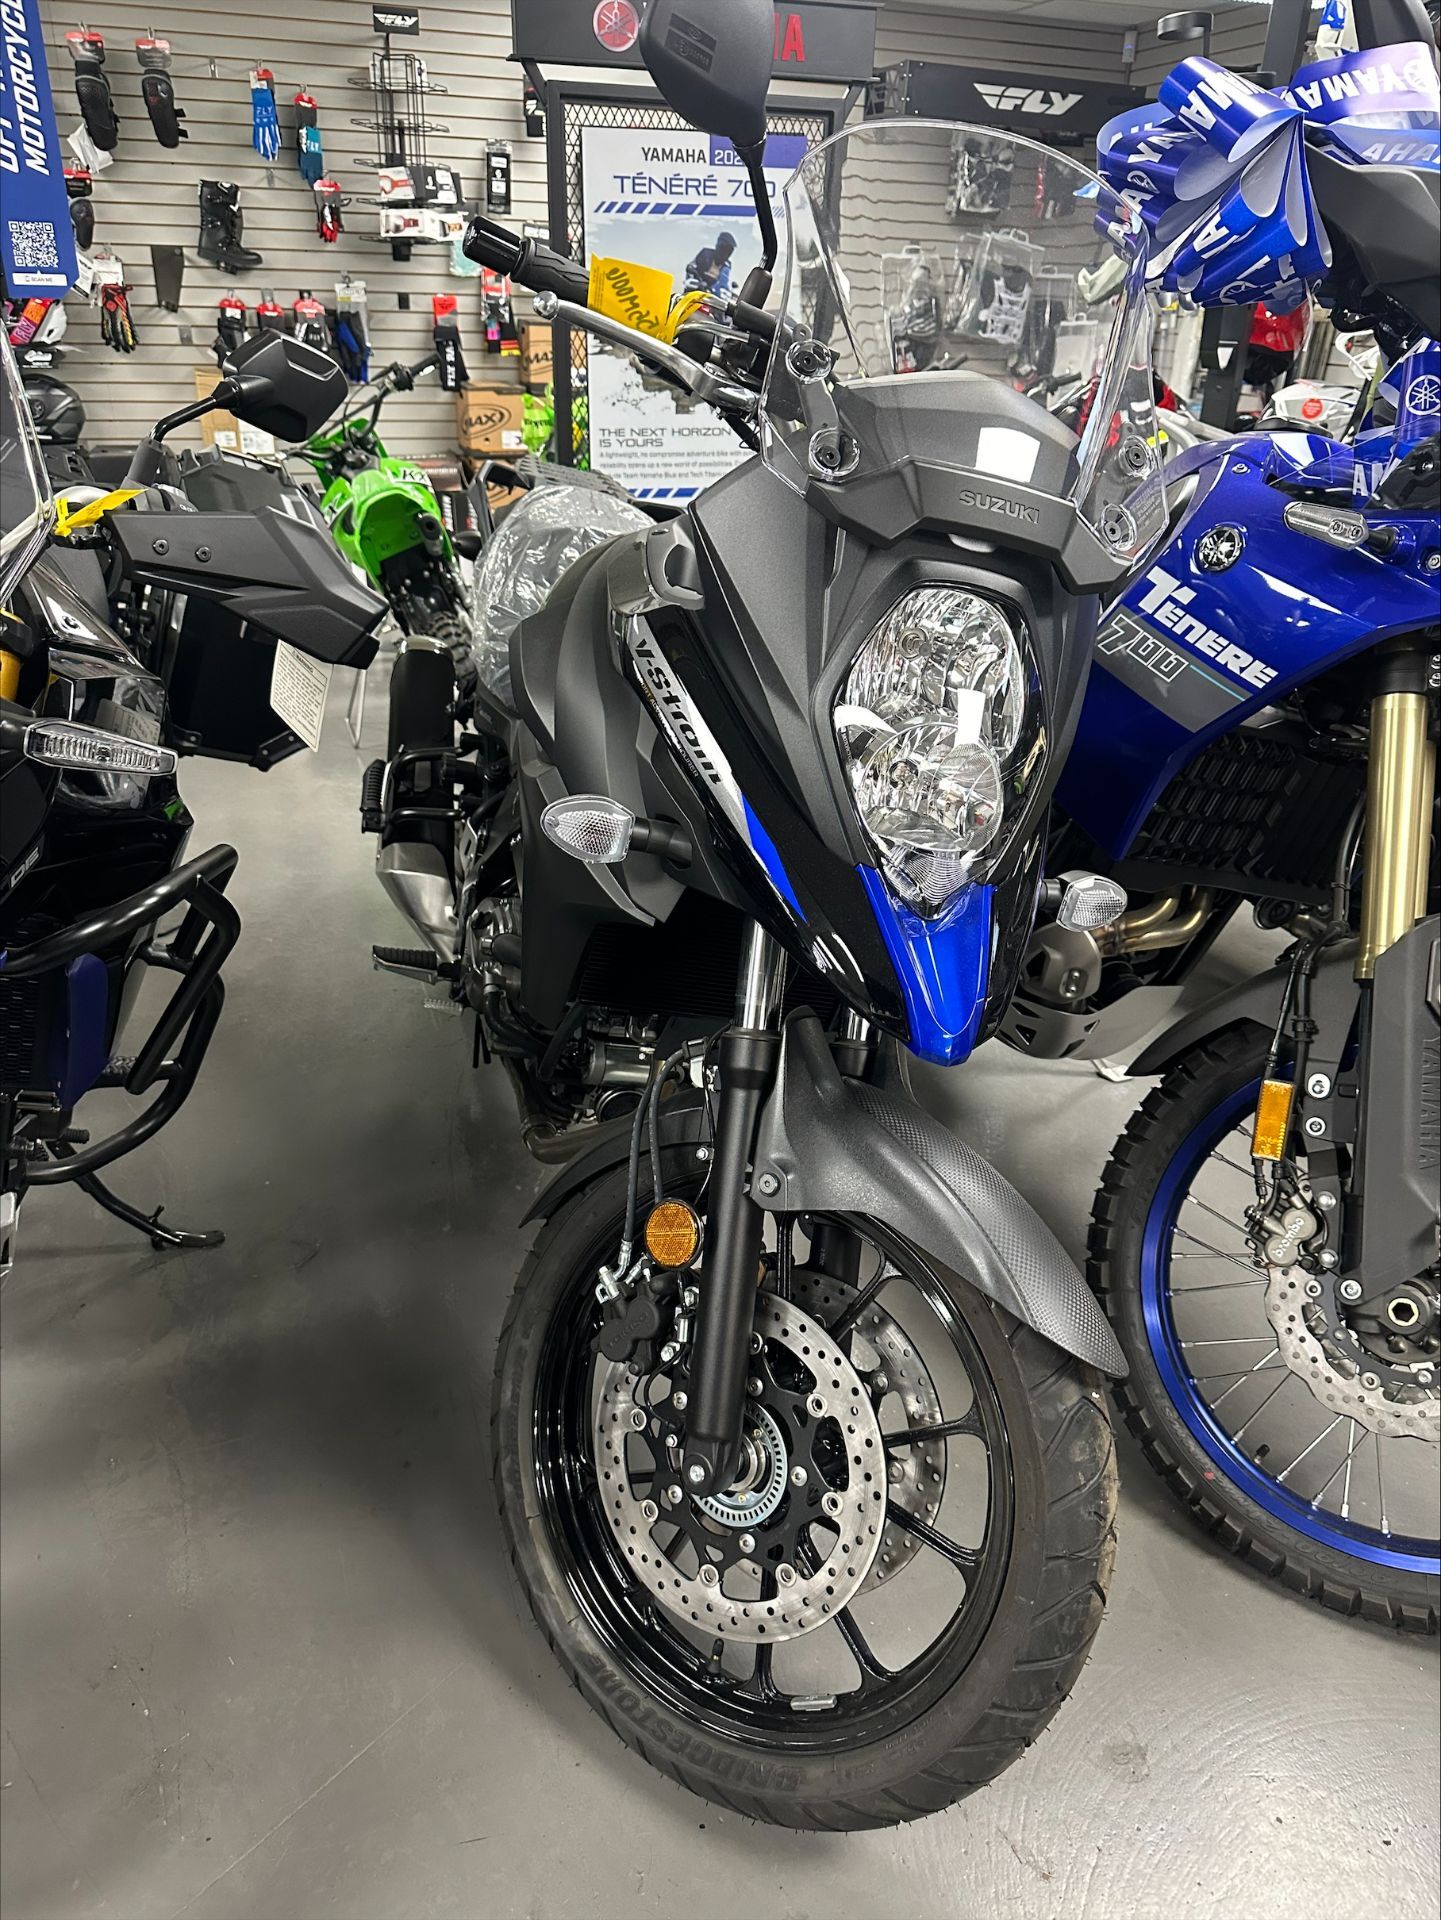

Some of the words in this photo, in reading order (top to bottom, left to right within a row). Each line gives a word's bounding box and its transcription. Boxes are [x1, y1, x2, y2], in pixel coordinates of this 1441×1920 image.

[973, 82, 1084, 116] FLY
[641, 147, 707, 164] YAMAHA
[613, 172, 718, 197] TÉNÉRÉ
[600, 428, 626, 437] THE
[631, 428, 667, 437] NEXT
[672, 428, 732, 436] HORIZON
[600, 438, 612, 447] IS
[616, 438, 664, 447] YOURS
[959, 489, 1040, 525] SUZUKI
[1097, 613, 1190, 683] 700
[635, 638, 722, 785] V-Strom
